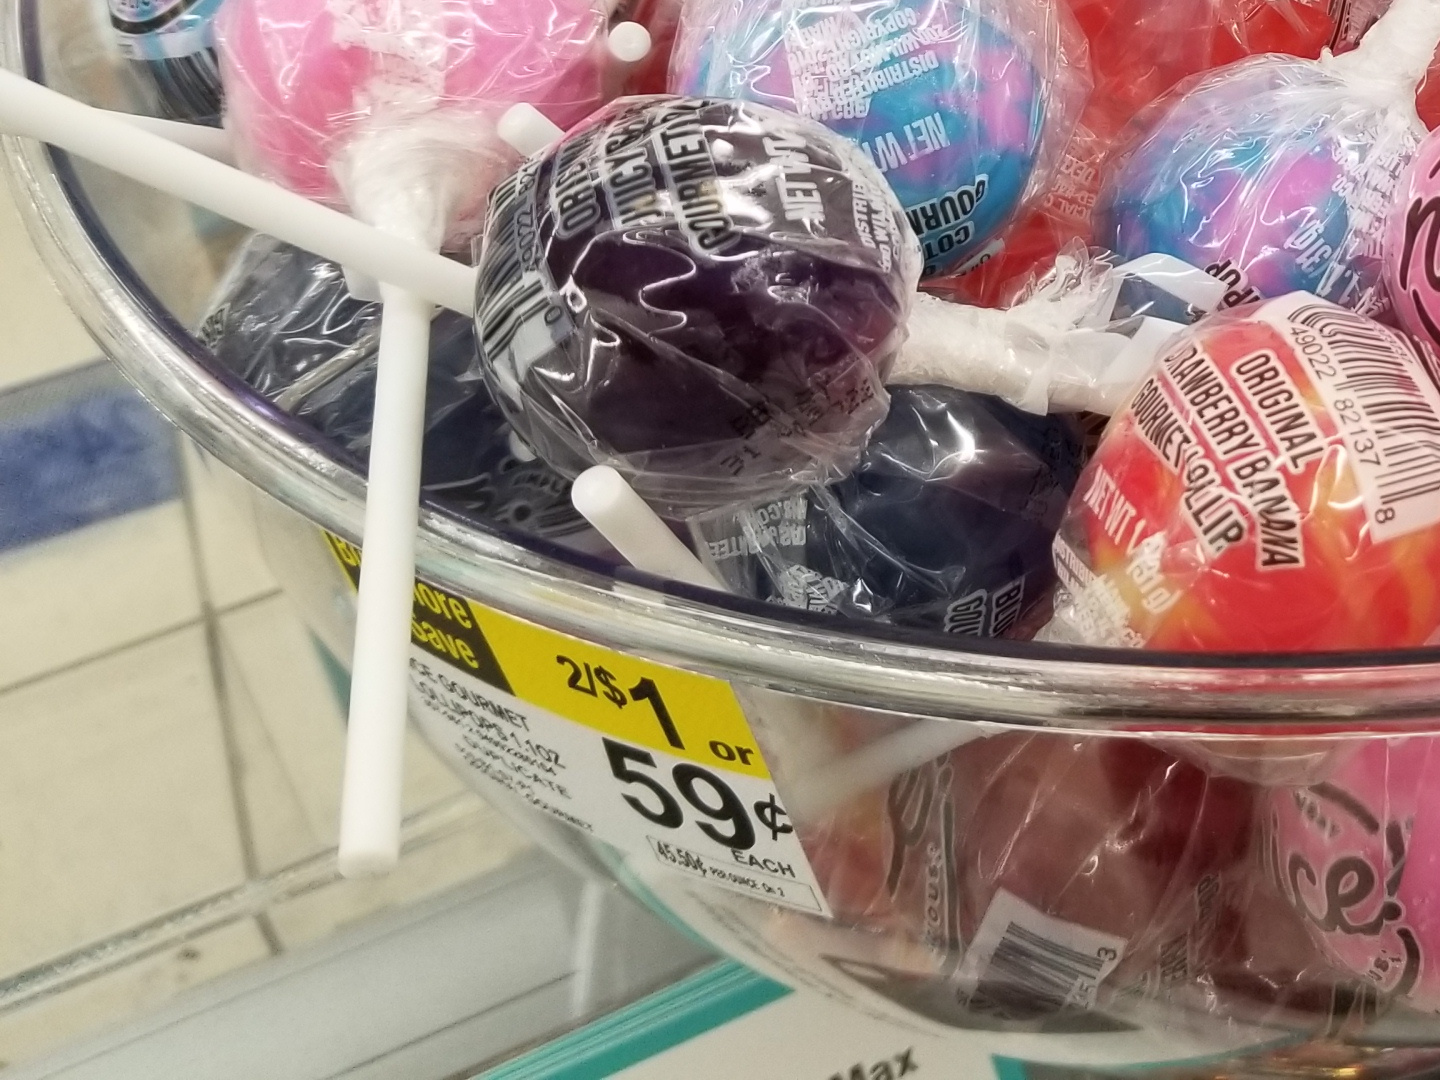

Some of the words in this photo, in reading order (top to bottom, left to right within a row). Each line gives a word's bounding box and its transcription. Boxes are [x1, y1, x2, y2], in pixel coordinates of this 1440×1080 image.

[901, 111, 950, 162] NET
[922, 221, 972, 256] COT
[1131, 378, 1195, 470] GOURMET
[1236, 353, 1325, 471] ORIGINAL
[1291, 325, 1336, 381] 49022
[1334, 399, 1381, 467] 82137
[1374, 507, 1396, 525] 8
[1233, 454, 1301, 567] BANANA
[414, 581, 472, 630] ore
[436, 675, 532, 732] GOURMET
[556, 653, 687, 752] 2/$1
[708, 739, 755, 767] or
[601, 735, 794, 852] 59¢
[731, 848, 797, 879] EACH
